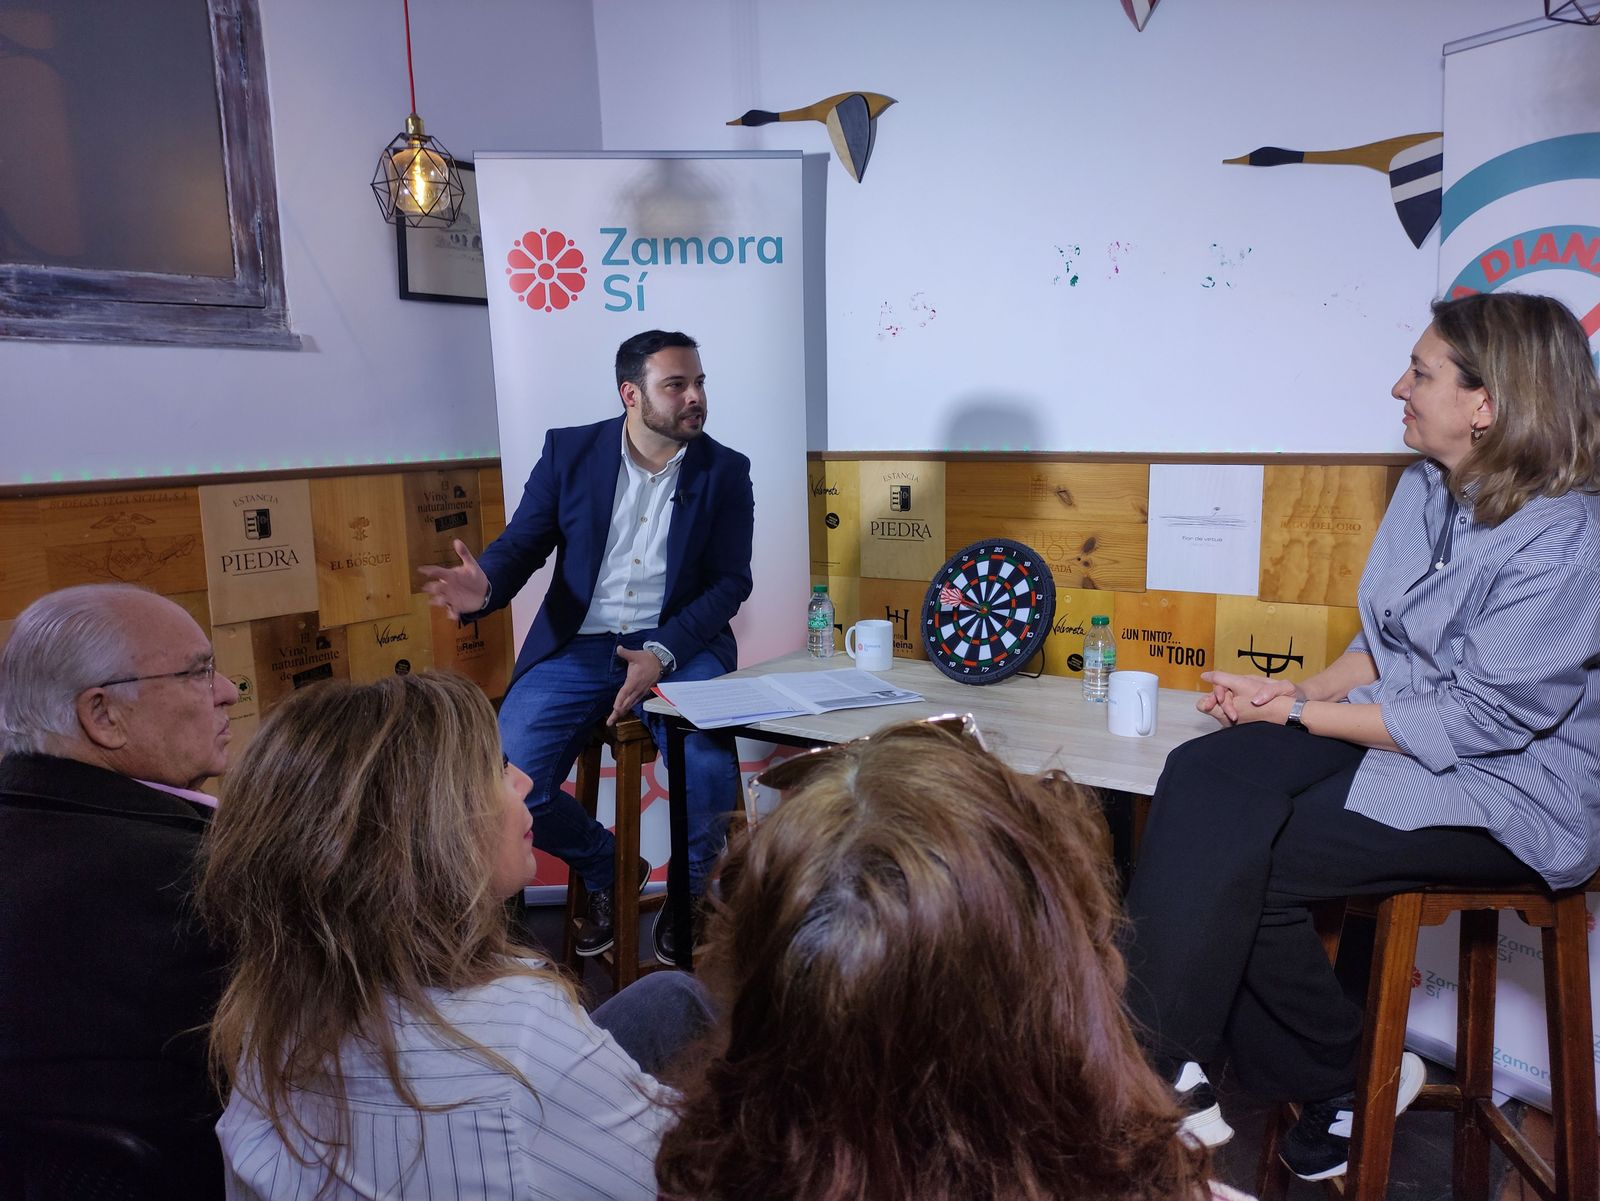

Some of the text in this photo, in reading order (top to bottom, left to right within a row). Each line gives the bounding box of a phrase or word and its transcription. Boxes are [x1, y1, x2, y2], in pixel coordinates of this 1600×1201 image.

[600, 228, 783, 265] Zamora
[1480, 231, 1600, 283] DIAN
[603, 272, 648, 312] Sí
[883, 472, 919, 482] ESTANCIA
[233, 494, 278, 507] ESTANCIA
[424, 491, 448, 503] Vino
[418, 500, 473, 513] naturalmente
[870, 521, 932, 539] PIEDRA
[1336, 523, 1361, 531] ORO
[221, 549, 299, 573] PIEDRA
[330, 561, 343, 571] EL
[346, 553, 391, 568] BOSQUE
[1121, 628, 1181, 645] ¿UN TINTO?...
[280, 646, 308, 657] Vino
[1150, 644, 1206, 667] UN TORO
[271, 651, 340, 672] naturalmente
[280, 670, 293, 681] de
[1425, 984, 1440, 1000] Sí
[1493, 1047, 1549, 1080] Zamor
